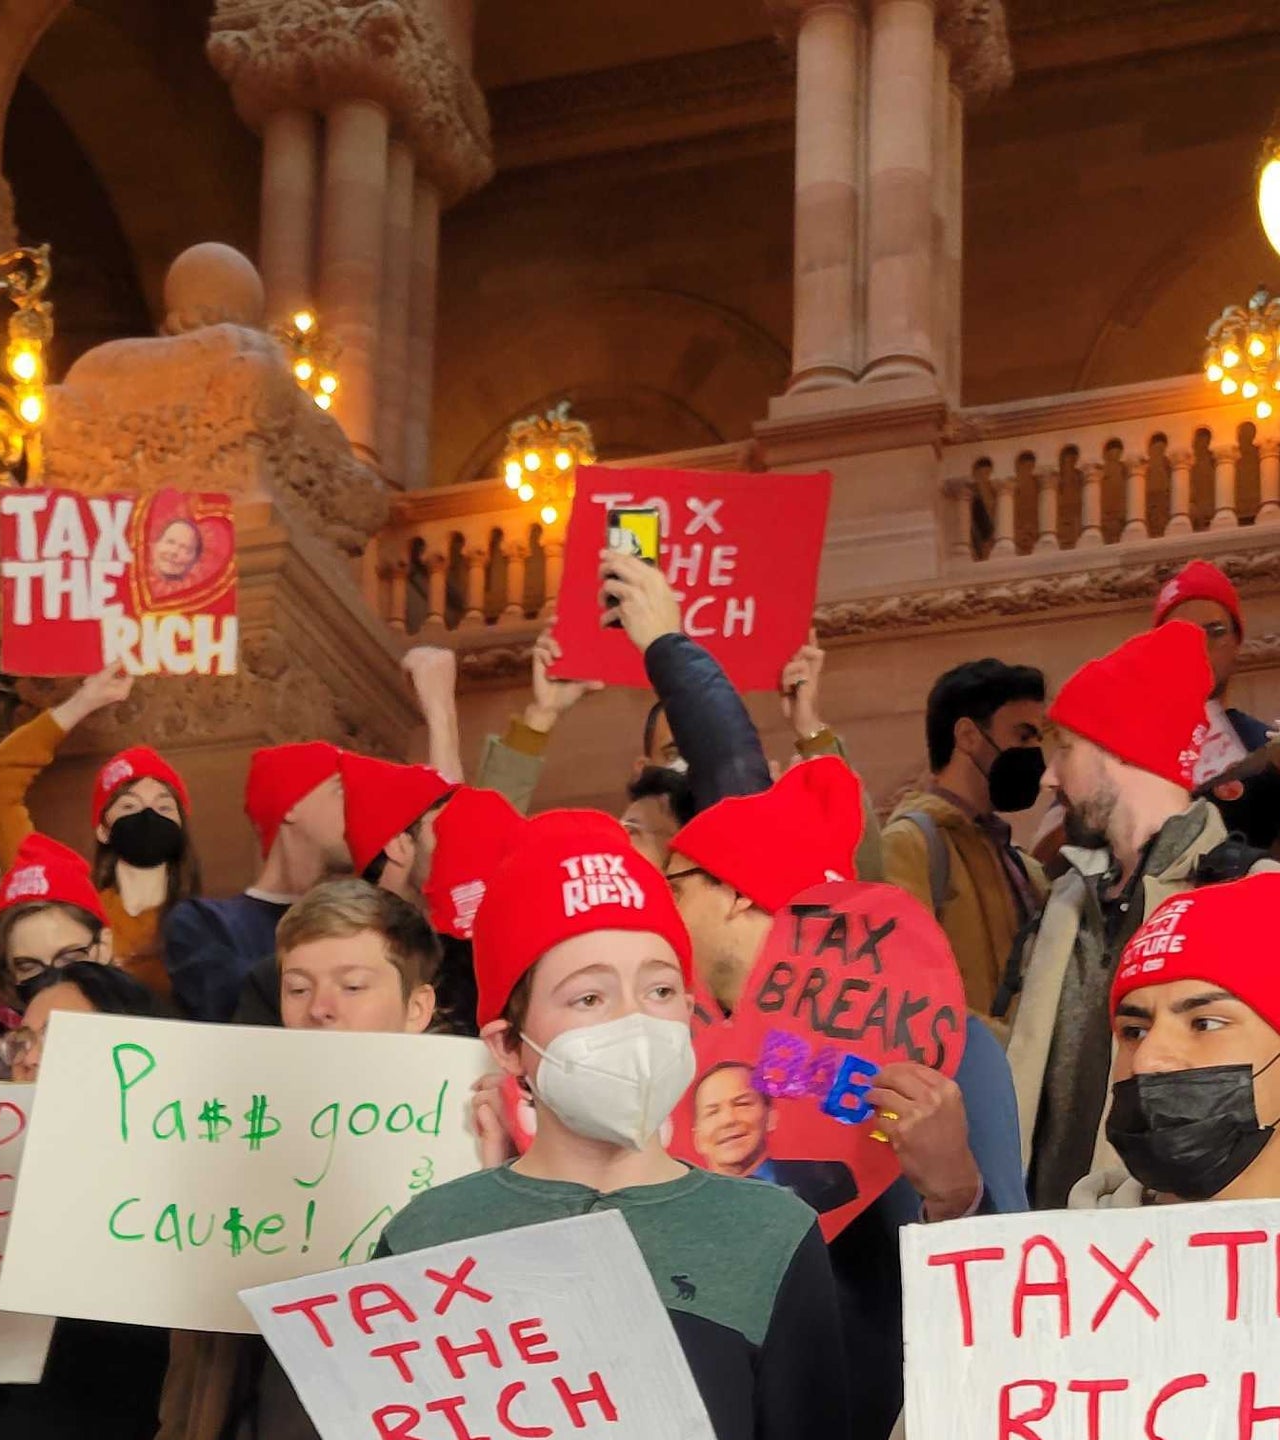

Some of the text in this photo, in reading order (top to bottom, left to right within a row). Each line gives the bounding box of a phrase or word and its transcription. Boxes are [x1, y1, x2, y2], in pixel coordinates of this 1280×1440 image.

[0, 494, 134, 563] TAX
[1, 559, 125, 626] THE
[659, 543, 738, 587] HE
[101, 612, 238, 677] RICH
[670, 590, 756, 638] CH
[560, 853, 628, 879] TAX
[562, 874, 645, 917] RICH
[789, 904, 898, 974] TAX
[756, 961, 958, 1070] BREAKS
[751, 1029, 898, 1141] BAB
[293, 1079, 449, 1188] good
[272, 1256, 494, 1348] TAX
[927, 1234, 1161, 1347] TAX
[370, 1317, 560, 1384] THE
